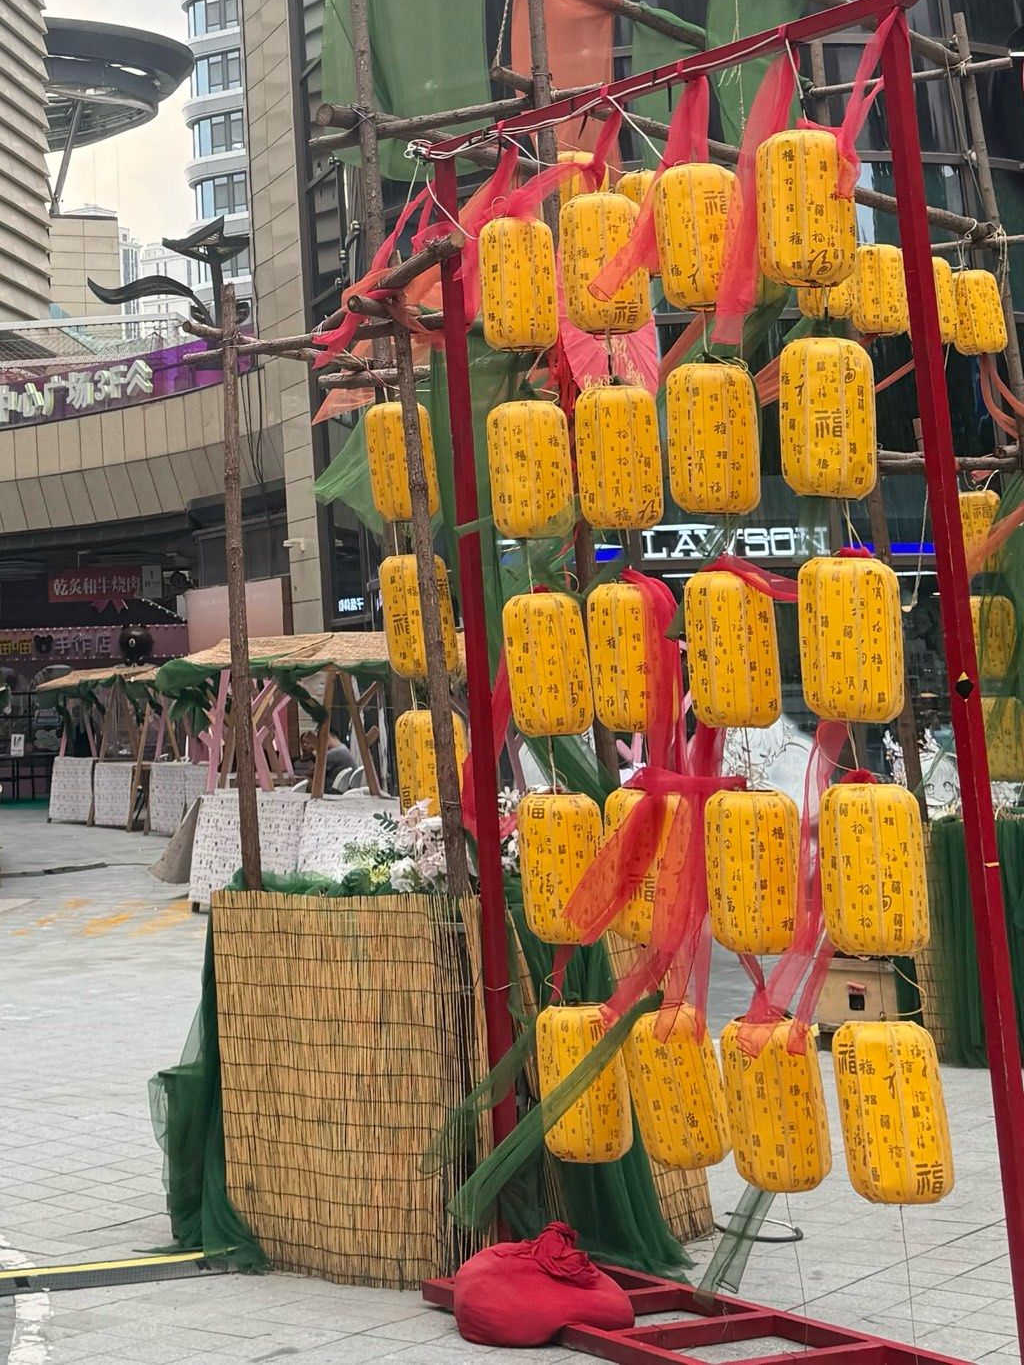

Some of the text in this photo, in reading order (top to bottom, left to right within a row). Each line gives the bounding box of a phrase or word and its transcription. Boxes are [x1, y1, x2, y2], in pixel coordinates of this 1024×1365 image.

[614, 300, 638, 324] 福
[815, 409, 842, 438] 福
[53, 576, 141, 597] 乾炙和牛烧肉
[393, 614, 410, 635] 福
[838, 1043, 857, 1075] 福
[916, 1161, 944, 1195] 福
